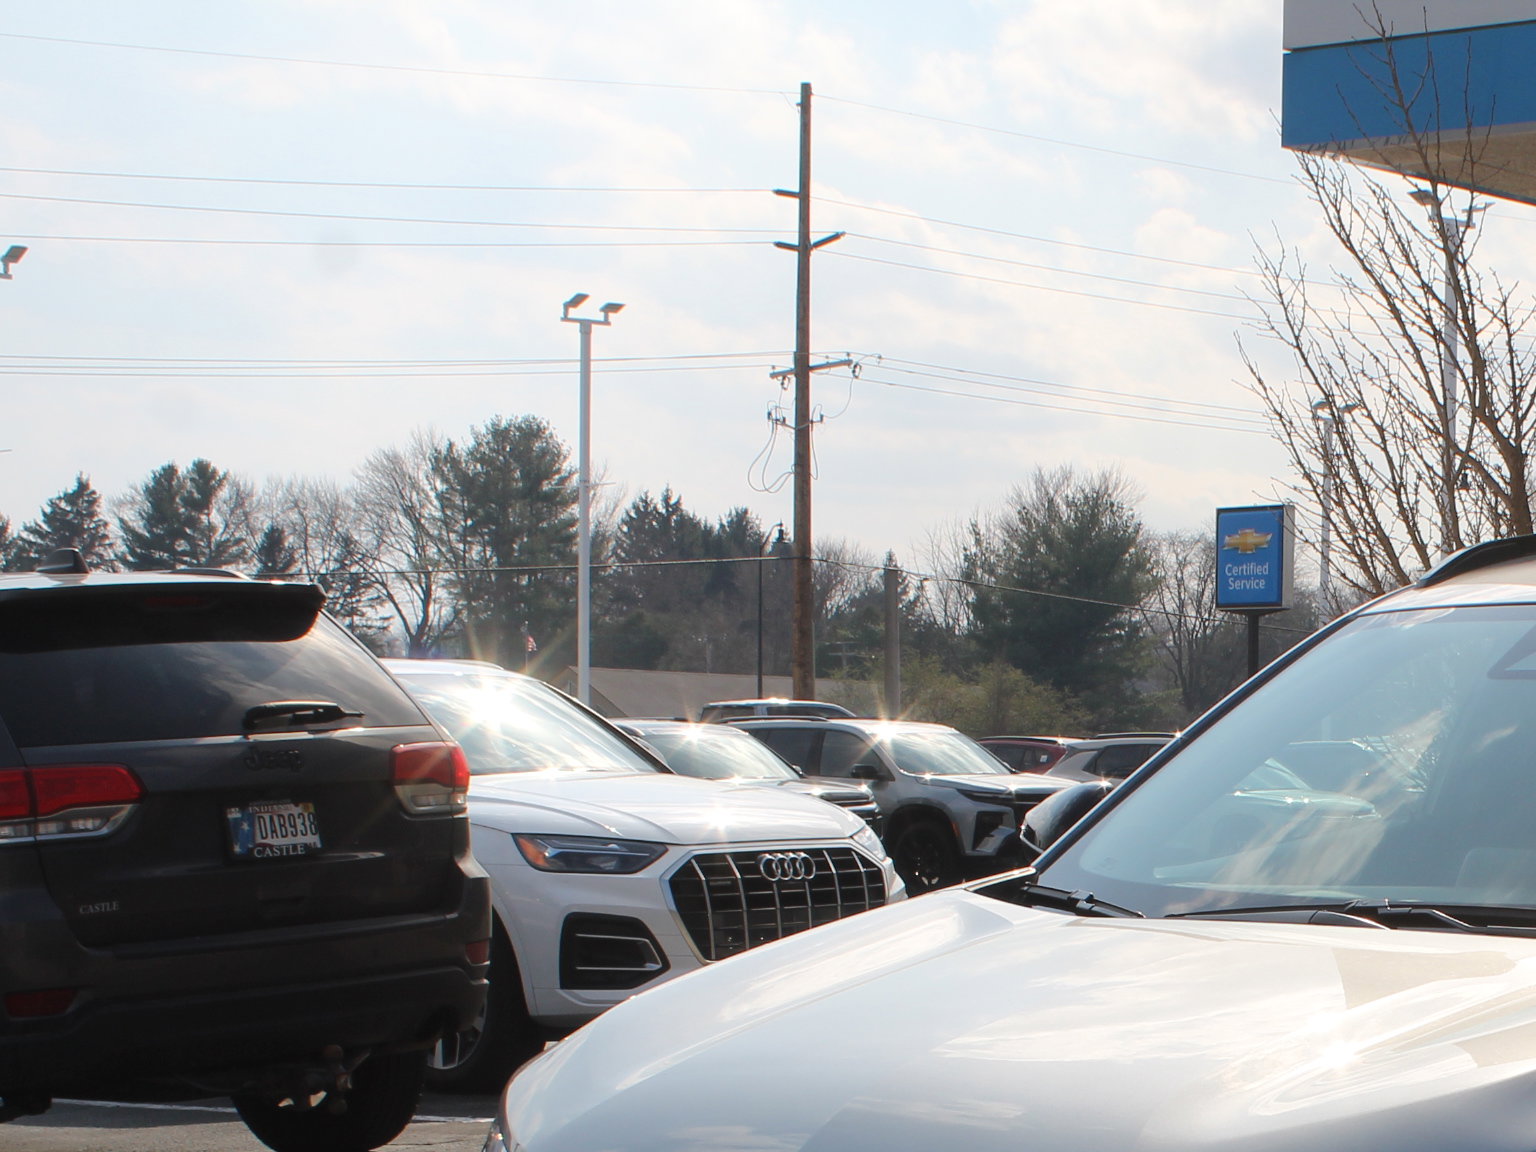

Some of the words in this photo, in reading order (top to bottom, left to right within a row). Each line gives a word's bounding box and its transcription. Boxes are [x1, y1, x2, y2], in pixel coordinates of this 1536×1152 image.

[1225, 562, 1269, 576] Certified
[1228, 577, 1266, 590] Service
[257, 812, 318, 840] DAB938
[254, 844, 306, 858] CASTLE
[79, 901, 120, 914] CASTLE
